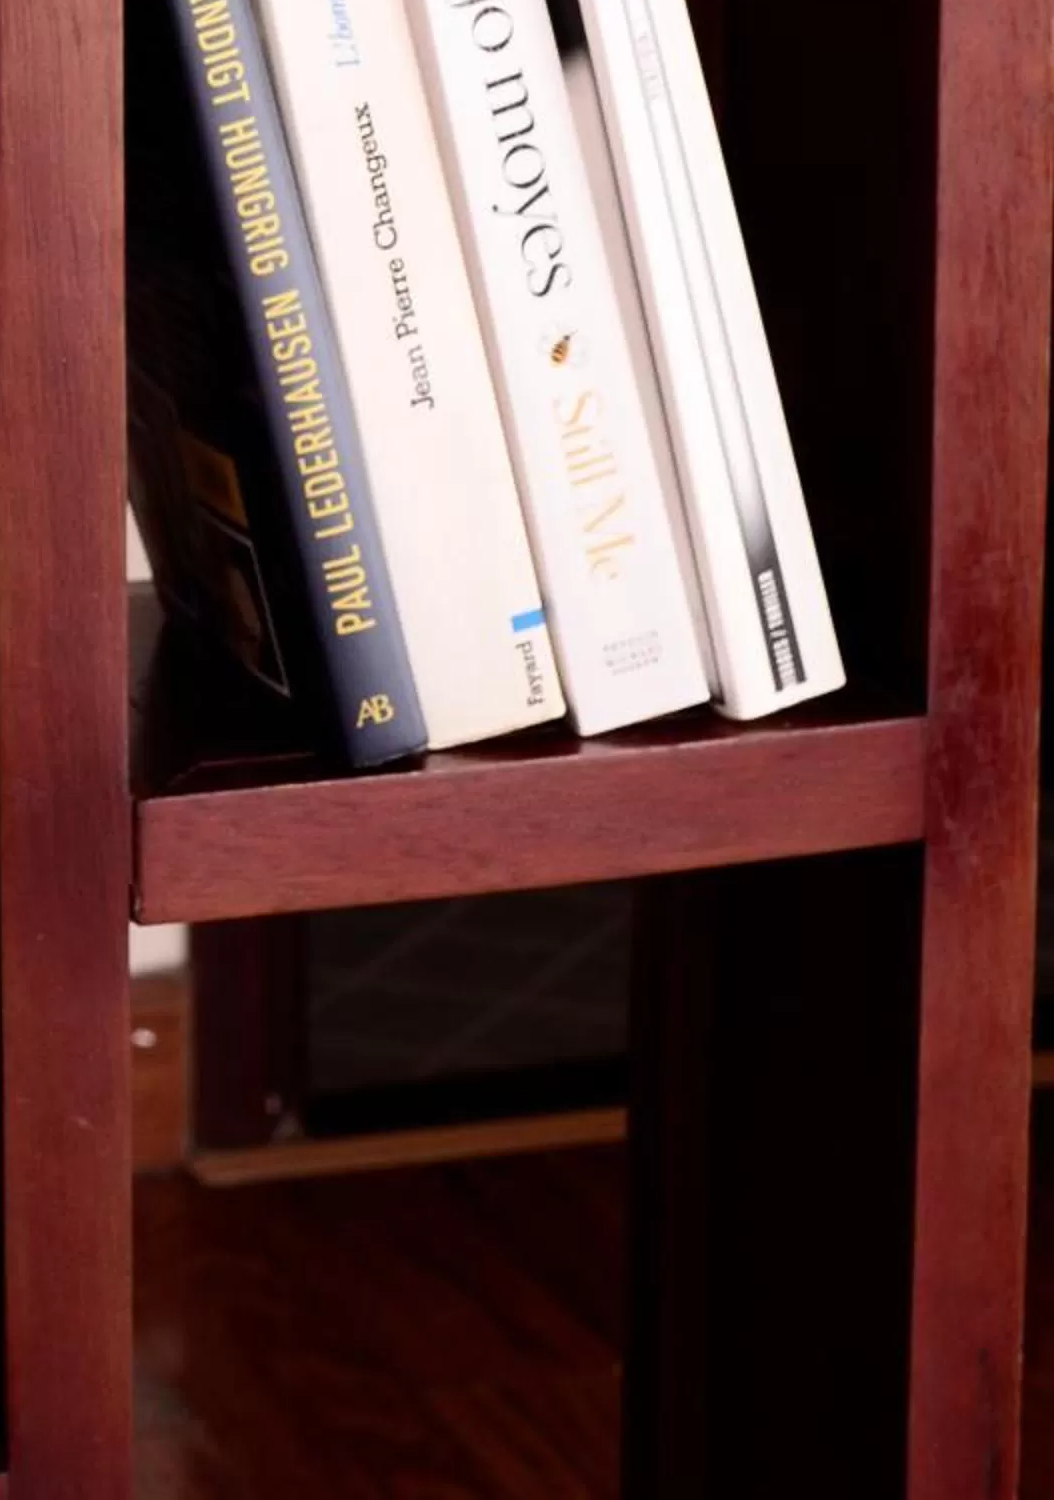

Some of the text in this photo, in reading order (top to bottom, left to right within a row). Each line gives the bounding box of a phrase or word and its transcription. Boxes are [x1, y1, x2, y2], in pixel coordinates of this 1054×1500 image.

[219, 116, 290, 277] HUNGRIG
[355, 101, 435, 411] Jean Pierre Changeux
[487, 69, 573, 298] moyes
[262, 287, 377, 637] PAUL LEDERHAUSEN
[356, 694, 395, 729] AB
